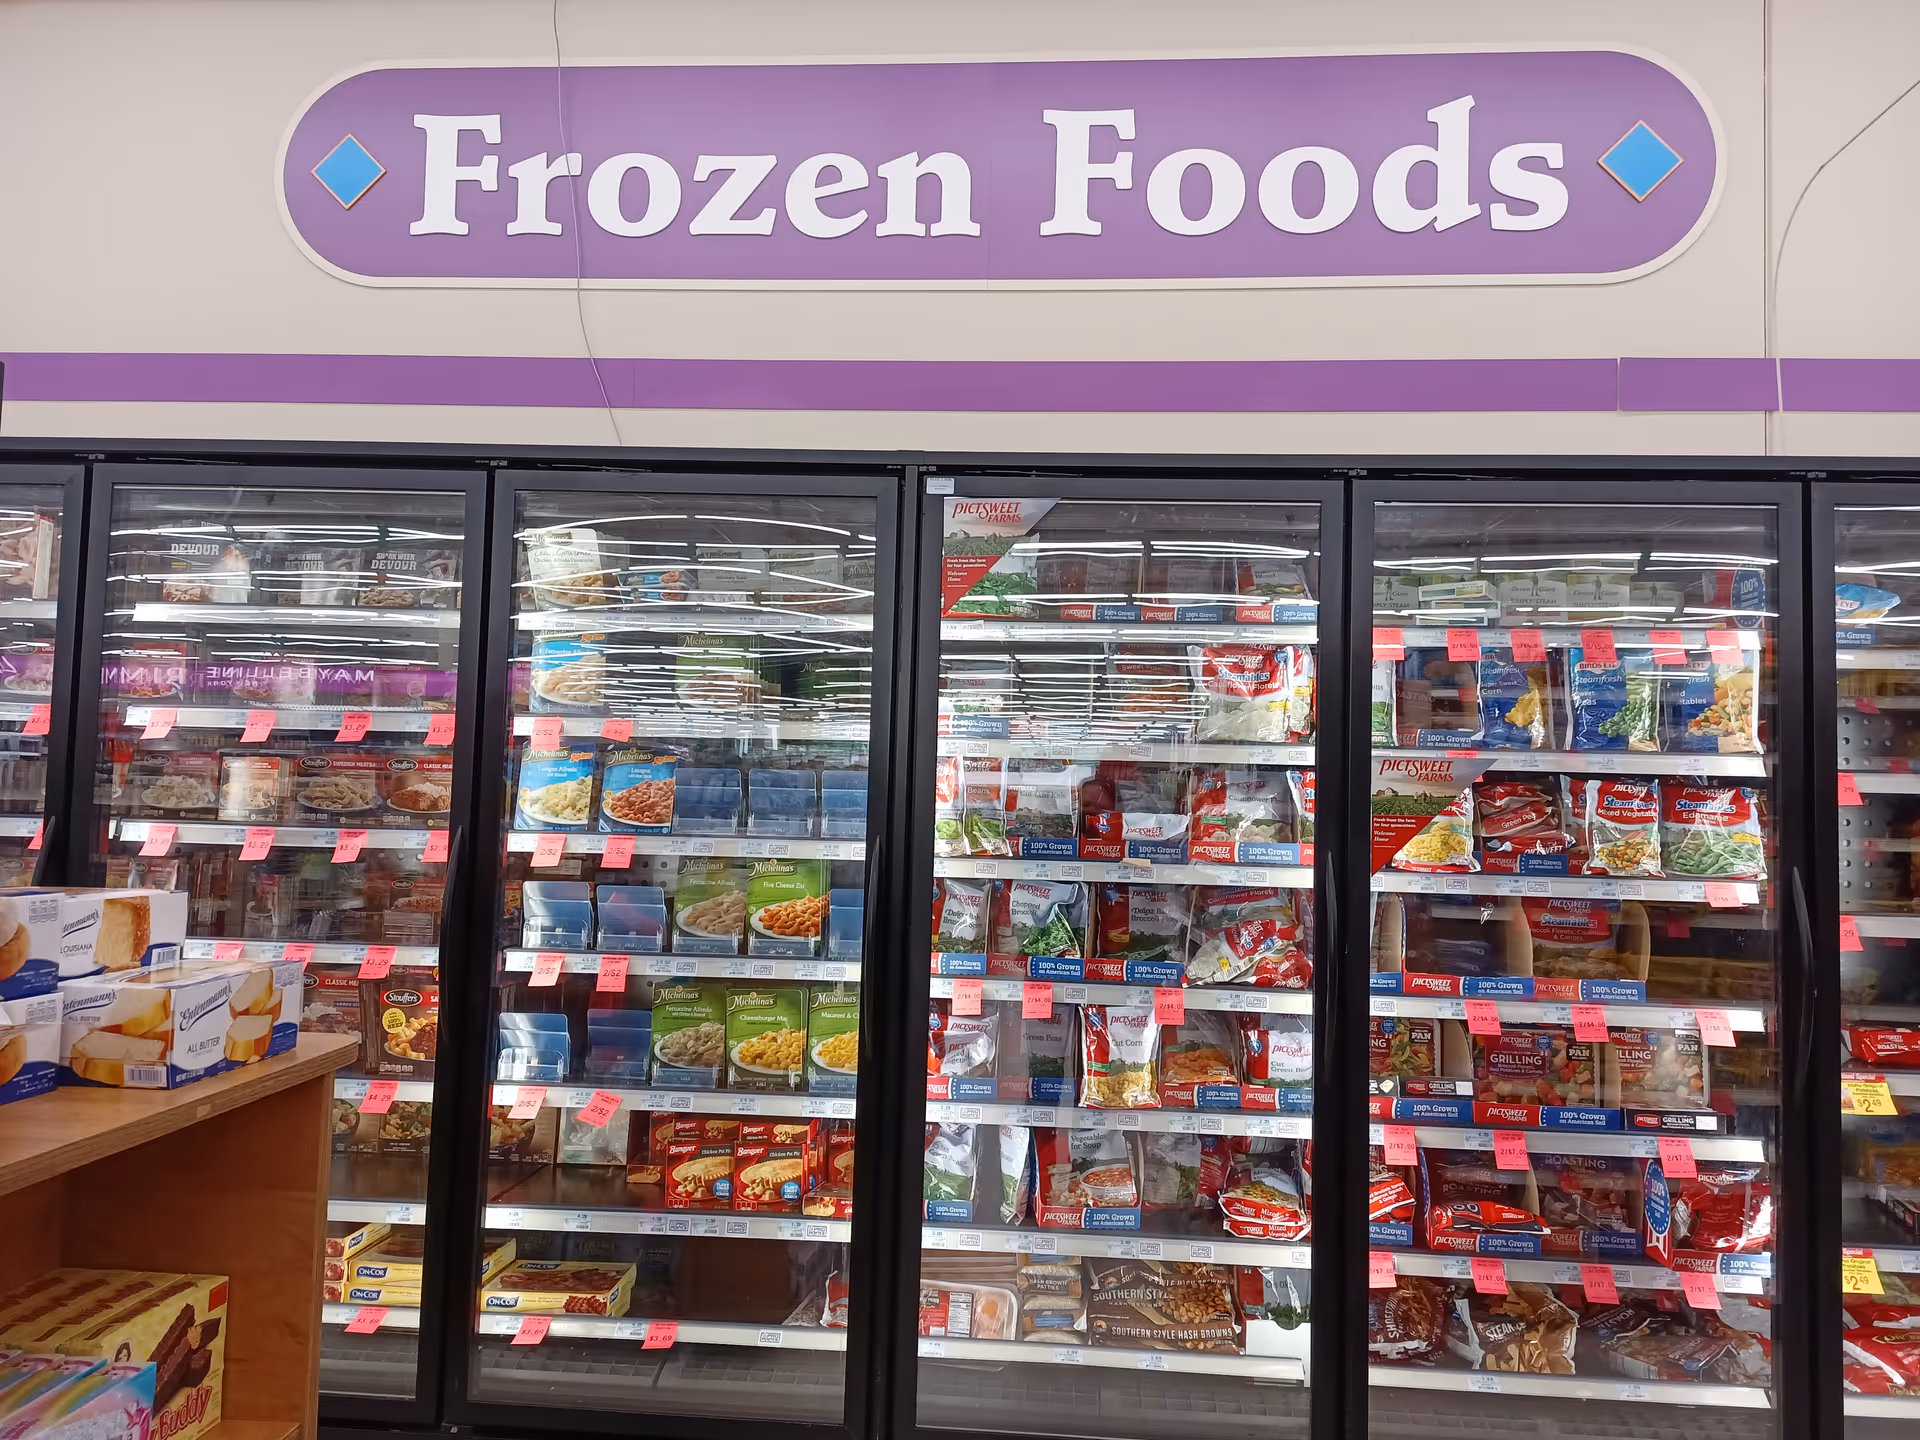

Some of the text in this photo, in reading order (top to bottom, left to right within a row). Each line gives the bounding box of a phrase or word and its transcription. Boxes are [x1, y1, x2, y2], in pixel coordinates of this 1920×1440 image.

[409, 94, 1568, 239] Frozen Foods
[952, 501, 1022, 520] PICTSWEET
[987, 513, 1022, 523] FARMS
[170, 543, 220, 556] DEVOUR
[284, 559, 324, 571] DEVOUR
[371, 559, 417, 571] DEVOUR
[1739, 578, 1759, 594] 100%
[1838, 600, 1856, 610] EYE
[1847, 631, 1872, 640] Grown
[1578, 662, 1602, 670] BIRDS
[1575, 674, 1623, 685] Steamfresh
[1481, 688, 1503, 696] Corn
[344, 724, 366, 732] $3.29
[432, 726, 455, 735] $3.29
[528, 750, 569, 761] Michelina's
[610, 752, 653, 765] Michelina's
[333, 760, 355, 768] SWEDISH
[1378, 759, 1454, 777] PICTSWEET
[630, 767, 651, 775] Lasagna
[1417, 772, 1454, 783] FARMS
[968, 787, 991, 795] Beans
[1682, 812, 1729, 822] Edamame
[1501, 815, 1522, 829] Green
[247, 840, 269, 849] $3.29
[1030, 842, 1048, 850] 100%
[539, 846, 557, 857] 2/$2
[607, 845, 627, 856] 2/$2
[1037, 848, 1062, 856] American
[1191, 845, 1231, 856] PICTSWEET
[682, 859, 724, 873] Michelina's
[749, 861, 795, 876] Michelina's
[763, 881, 774, 889] Five
[795, 882, 805, 890] Ziti
[1013, 883, 1052, 895] PICTSWEET
[1033, 890, 1051, 900] FARMS
[1011, 899, 1041, 911] Chopped
[1011, 908, 1037, 917] Broccoli
[60, 942, 93, 954] LOUISIANA
[365, 958, 389, 967] $3.29
[1038, 961, 1055, 969] 100%
[537, 967, 556, 976] 2/$2
[1046, 968, 1070, 976] American
[1087, 962, 1123, 973] PICTSWEET
[1152, 966, 1177, 974] Grown
[602, 968, 622, 978] 2/$2
[325, 979, 348, 987] CLASSIC
[1411, 976, 1452, 990] PICTSWEET
[1478, 980, 1523, 990] 100% Grown
[1431, 984, 1452, 993] FARMS
[1512, 988, 1524, 996] Soil
[1592, 986, 1638, 995] 100% Grown
[388, 992, 418, 1004] Stouffer's
[659, 989, 699, 1002] Michelina's
[815, 993, 858, 1006] Michelina's
[178, 979, 234, 1026] Entenmann's
[733, 995, 774, 1008] Michelina's
[1026, 996, 1052, 1005] 2/$4.00
[693, 1006, 712, 1014] Alfredo
[1159, 1002, 1185, 1011] 2/$4.00
[68, 1015, 101, 1023] ALL BUTTER
[739, 1014, 789, 1023] Cheeseburger Mac
[1109, 1015, 1149, 1027] PICTSWEET
[1472, 1014, 1499, 1023] 2/$4.00
[1578, 1020, 1606, 1029] 2/$4.00
[1411, 1031, 1432, 1040] PAN
[187, 1036, 221, 1054] ALL BUTTER
[1125, 1038, 1143, 1047] Corn
[1676, 1043, 1698, 1053] PAN
[1568, 1049, 1590, 1058] PAN
[1270, 1060, 1284, 1068] Cut
[1489, 1053, 1543, 1066] GRILLING
[1270, 1066, 1293, 1074] Green
[1854, 1073, 1876, 1082] Special
[1428, 1081, 1455, 1090] GRILLING
[517, 1099, 537, 1108] 2/$2
[590, 1105, 610, 1118] 2/$2
[1413, 1104, 1458, 1113] 100% Grown
[1487, 1107, 1528, 1119] PICTSWEET
[1420, 1111, 1459, 1119] American Soil
[1507, 1114, 1528, 1123] FARMS
[1559, 1111, 1606, 1120] 100% Grown
[1595, 1118, 1606, 1126] Soil
[1662, 1116, 1695, 1124] GRILLING
[675, 1121, 697, 1131] Banquet
[742, 1125, 765, 1135] Banquet
[1070, 1134, 1105, 1145] Vegetables
[668, 1144, 698, 1155] Banquet
[1070, 1141, 1102, 1151] for Soup
[1388, 1142, 1415, 1150] 2/$7.00
[736, 1147, 765, 1157] Banquet
[1500, 1147, 1527, 1156] 2/$7.00
[1666, 1154, 1694, 1163] 2/$7.00
[1442, 1182, 1501, 1196] ROASTING
[1043, 1212, 1081, 1223] PICTSWEET
[1092, 1213, 1135, 1221] 100% Grown
[1268, 1224, 1287, 1232] Mixed
[1434, 1235, 1475, 1248] PICTSWEET
[1488, 1239, 1507, 1247] 100%
[1609, 1236, 1636, 1245] Grown
[1454, 1242, 1475, 1251] FARMS
[1729, 1259, 1749, 1268] 100%
[358, 1268, 386, 1277] ON-COR
[1478, 1274, 1504, 1283] 2/$7.00
[1036, 1283, 1059, 1291] PATTIES
[1589, 1280, 1616, 1289] 2/$7.00
[351, 1289, 379, 1299] ON-COR
[1093, 1287, 1144, 1302] SOUTHERN
[488, 1297, 517, 1308] ON-COR
[1111, 1326, 1233, 1341] SOUTHERN STYLE HASH BROWNS
[1485, 1322, 1515, 1343] STEAK
[649, 1334, 672, 1342] $3.69
[160, 1383, 213, 1440] Buddy
